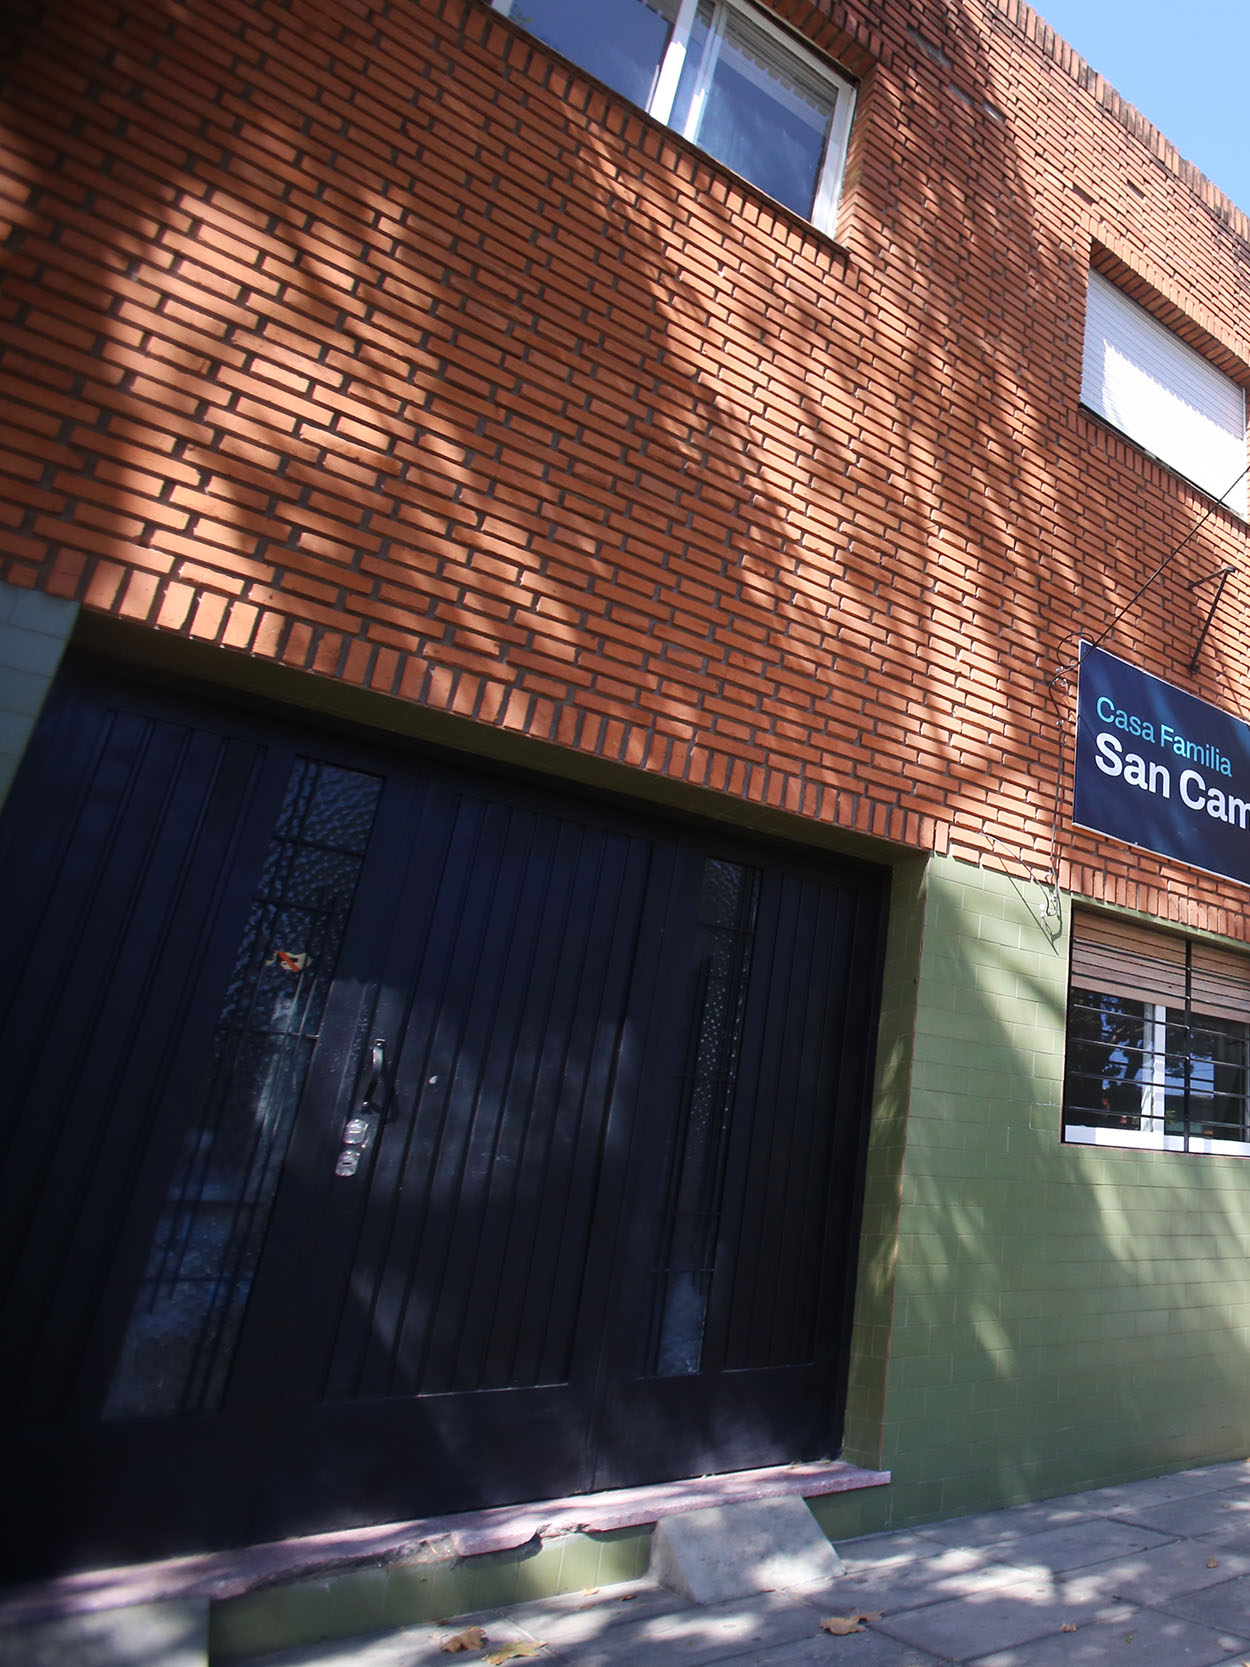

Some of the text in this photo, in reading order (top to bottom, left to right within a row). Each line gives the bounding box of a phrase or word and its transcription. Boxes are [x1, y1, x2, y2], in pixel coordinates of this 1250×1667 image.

[1095, 733, 1171, 799] San
[1096, 696, 1233, 777] Casa Familia
